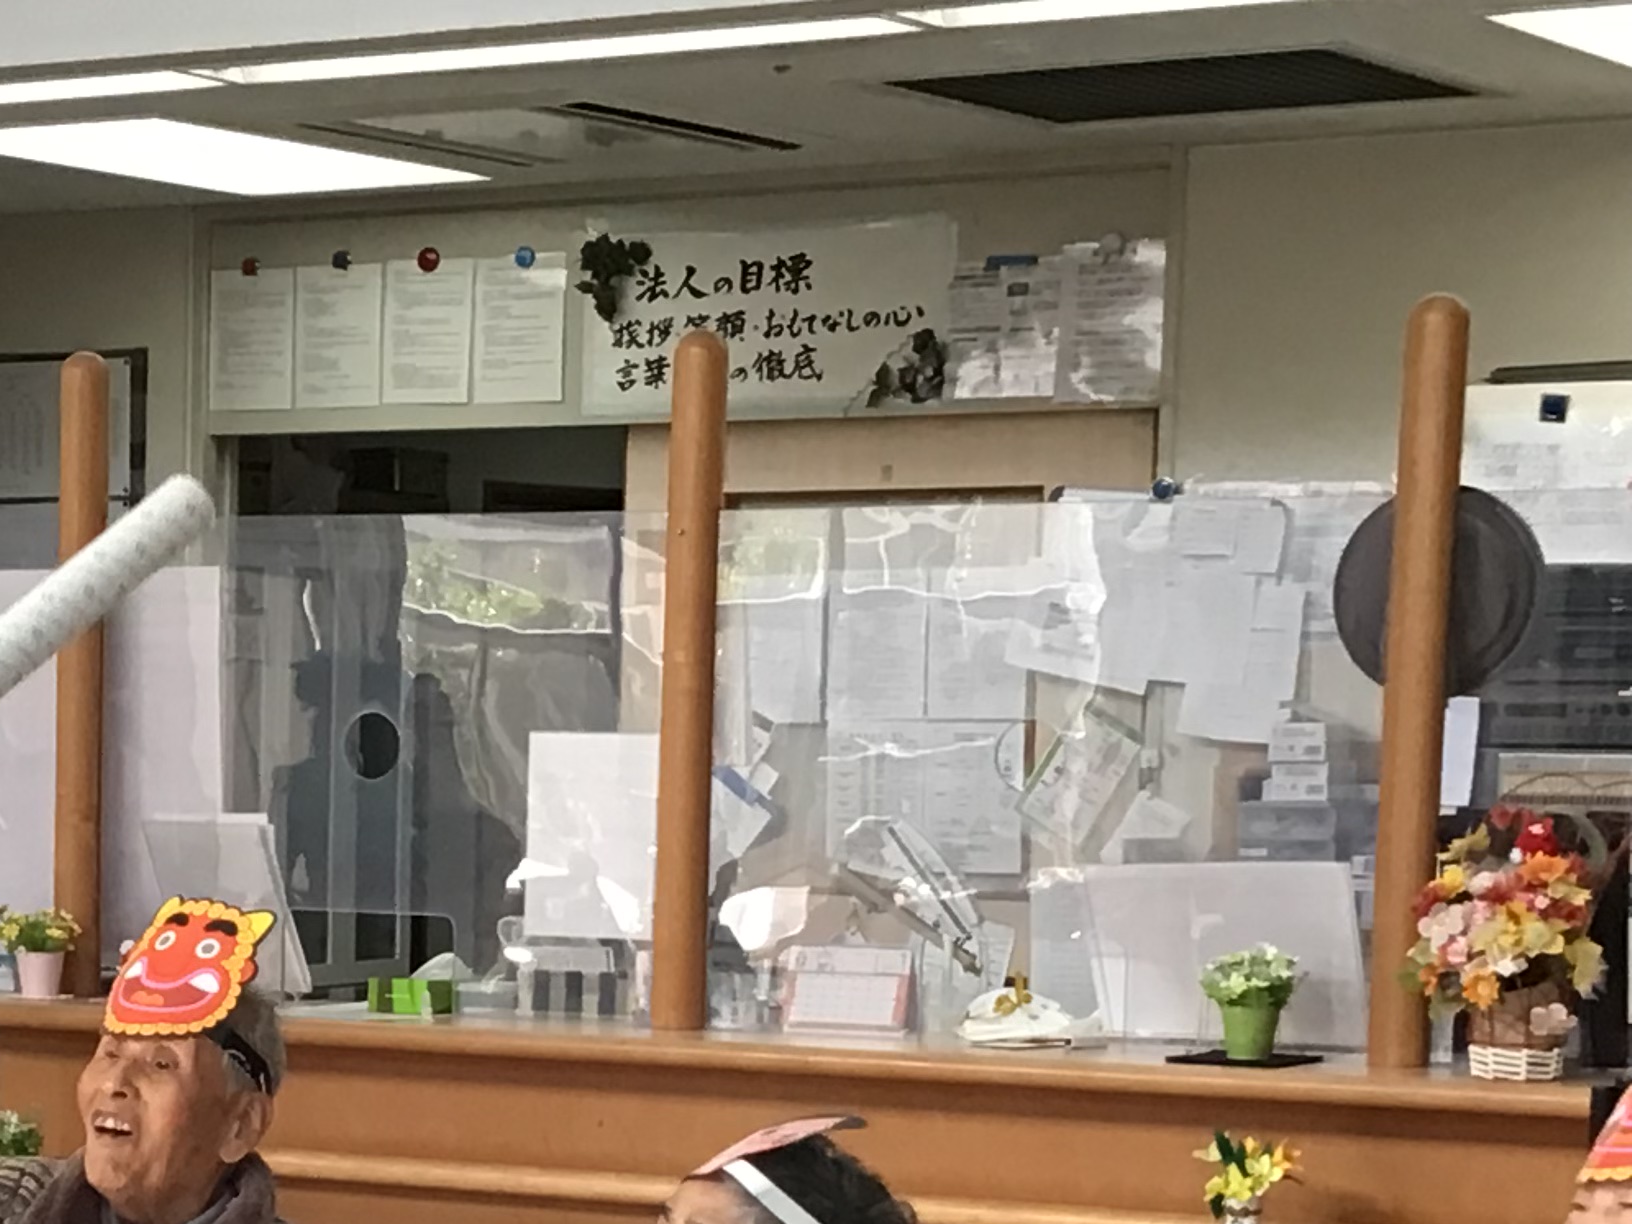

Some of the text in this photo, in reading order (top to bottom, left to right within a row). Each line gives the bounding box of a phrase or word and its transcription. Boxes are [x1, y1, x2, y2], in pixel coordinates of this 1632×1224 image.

[635, 252, 813, 303] 法人の目標
[615, 343, 824, 392] 言葉の徹底
